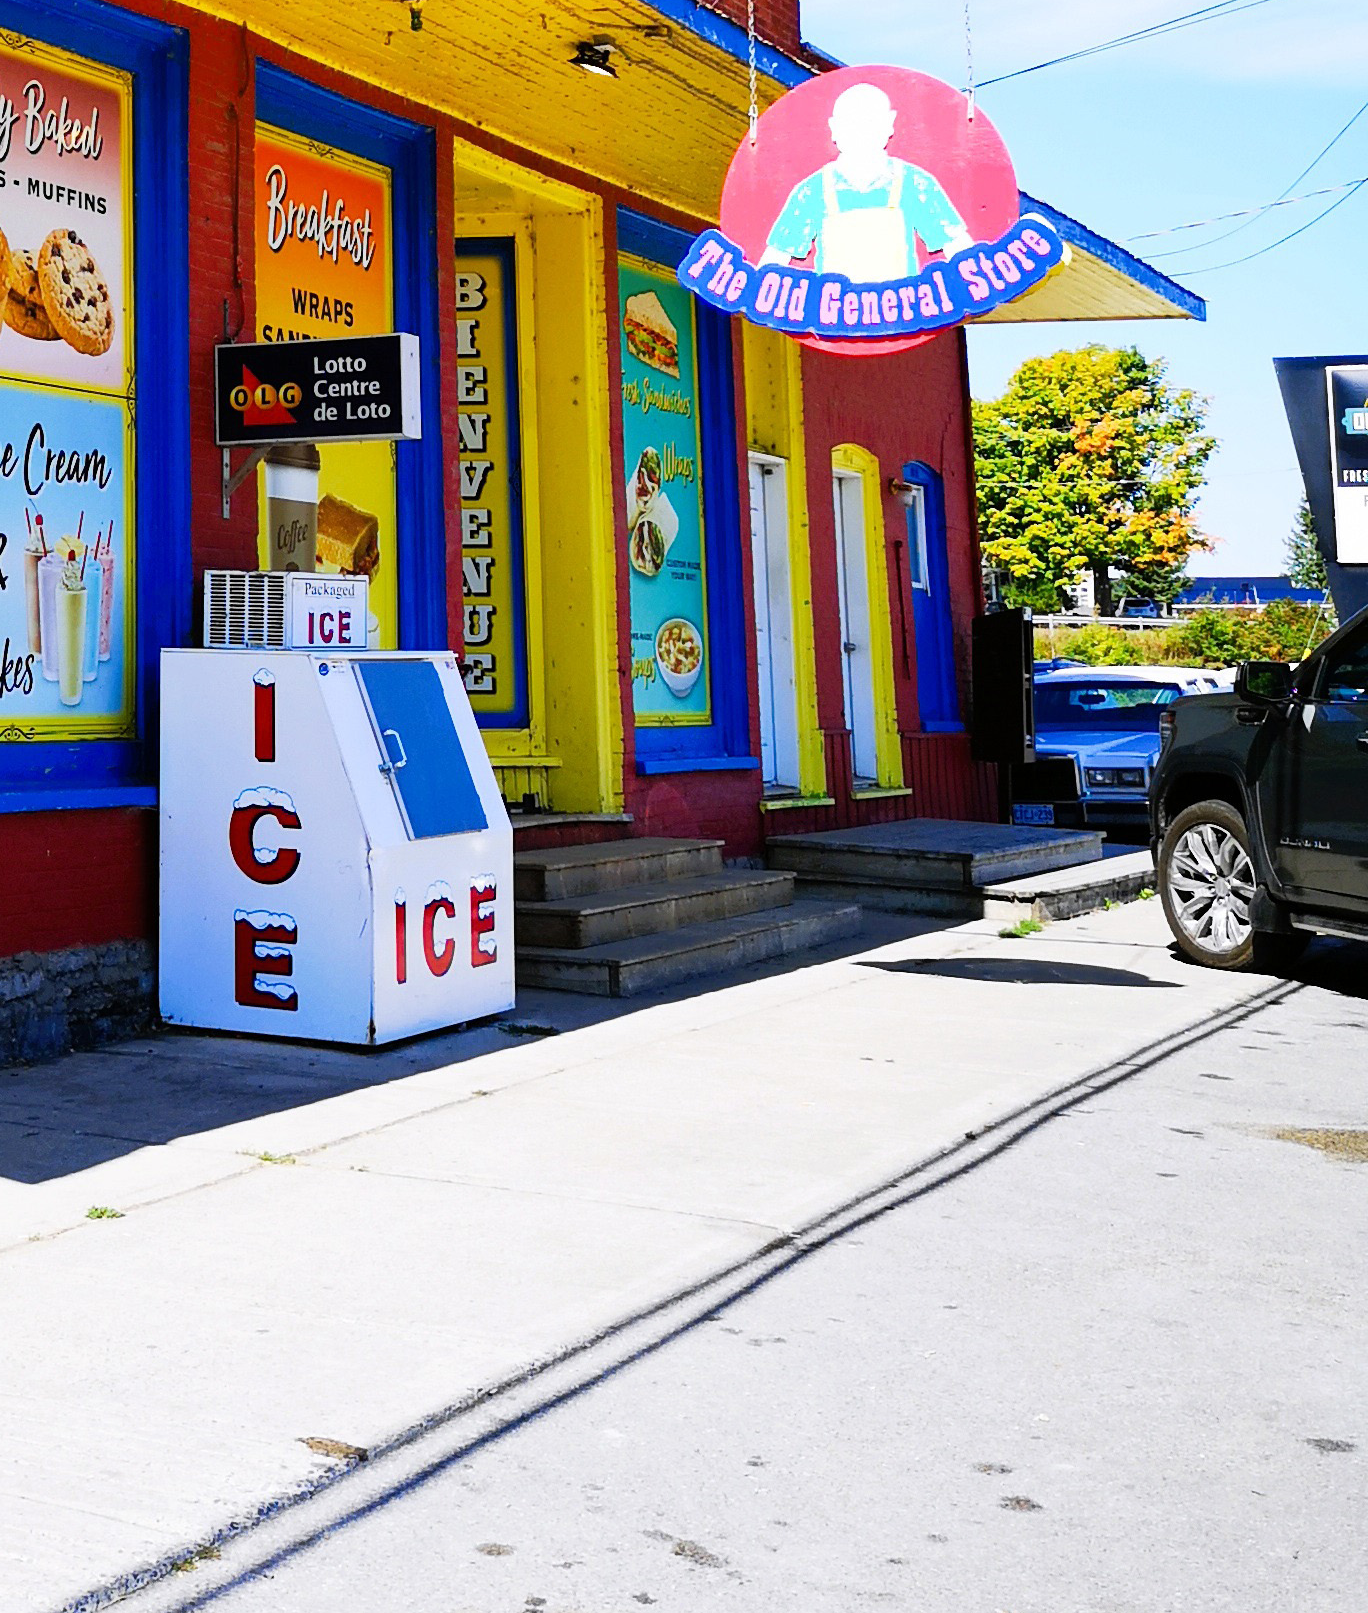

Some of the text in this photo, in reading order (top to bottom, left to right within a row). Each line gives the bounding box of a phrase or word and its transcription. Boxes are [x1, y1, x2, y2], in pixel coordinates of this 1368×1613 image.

[22, 78, 104, 161] Baked
[27, 177, 108, 215] MUFFINS
[265, 163, 376, 272] Breakfast
[686, 227, 1053, 327] The Old General Store
[291, 287, 354, 328] WRAPS
[313, 356, 367, 375] Lotto
[232, 385, 297, 408] OLG
[313, 379, 381, 399] Centre
[313, 402, 392, 422] de Loto
[23, 422, 113, 496] Cream
[455, 271, 497, 695] BIENVENUE
[276, 519, 309, 555] Coffee
[304, 582, 356, 601] Packaged
[307, 609, 352, 645] ICE
[228, 668, 303, 1012] ICE
[392, 871, 499, 986] ICE
